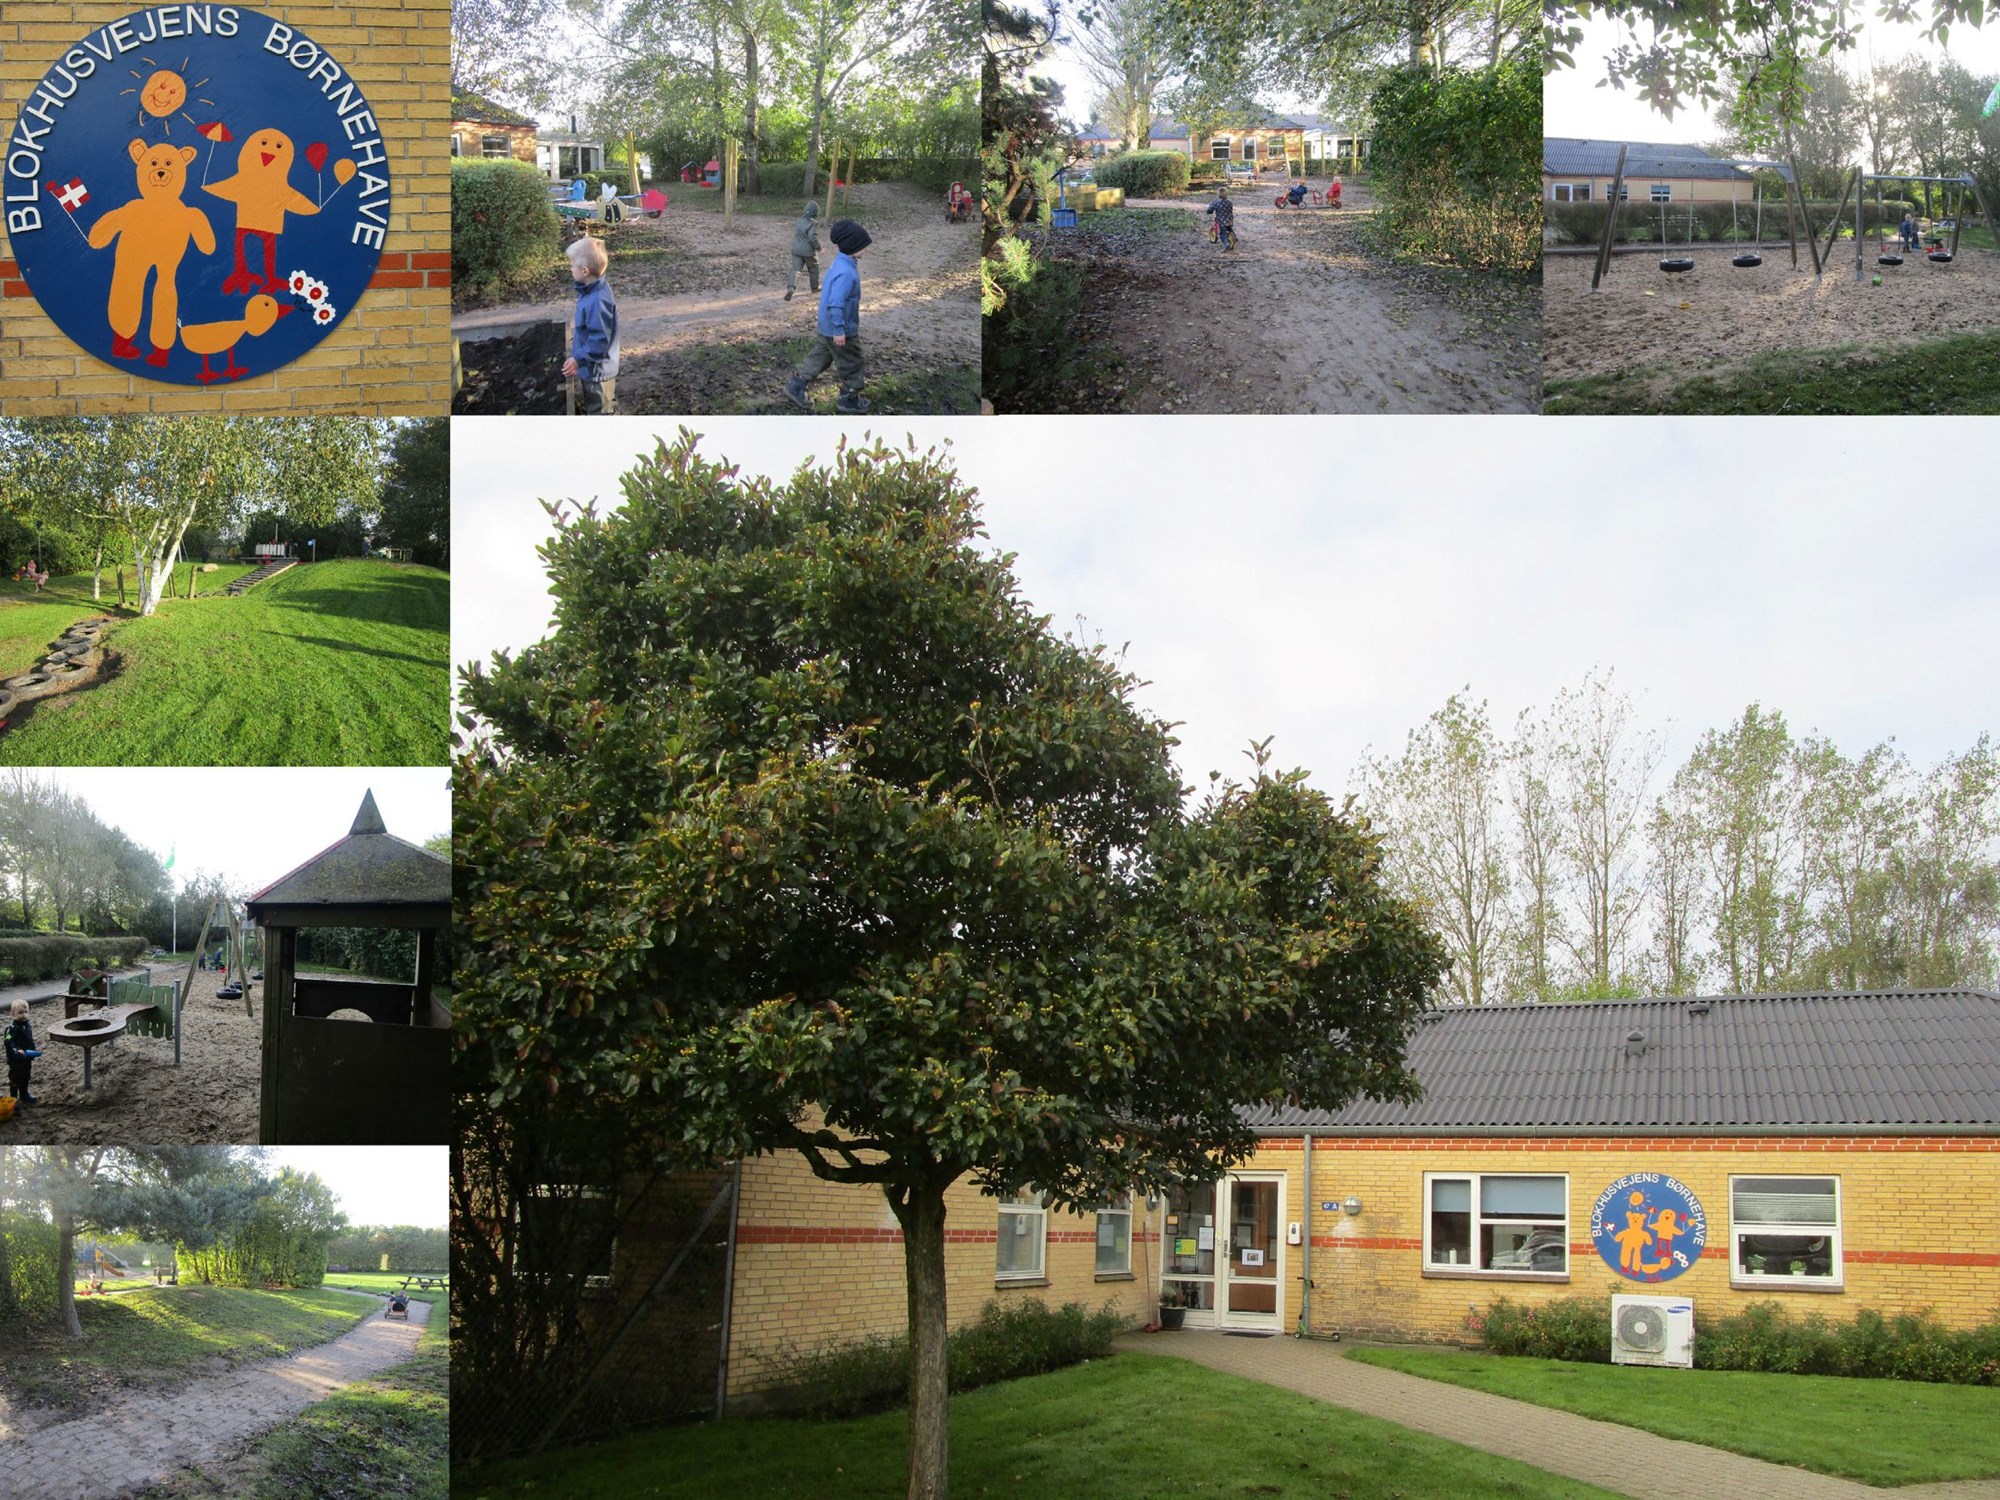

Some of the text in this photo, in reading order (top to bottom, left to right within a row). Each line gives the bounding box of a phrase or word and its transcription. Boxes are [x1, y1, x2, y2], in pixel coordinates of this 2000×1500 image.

[8, 6, 389, 249] BLOKHUSVEJENS BØRNEHAVE
[1592, 1173, 1706, 1246] BLOKHUSVEJENS BØRNEHAVE
